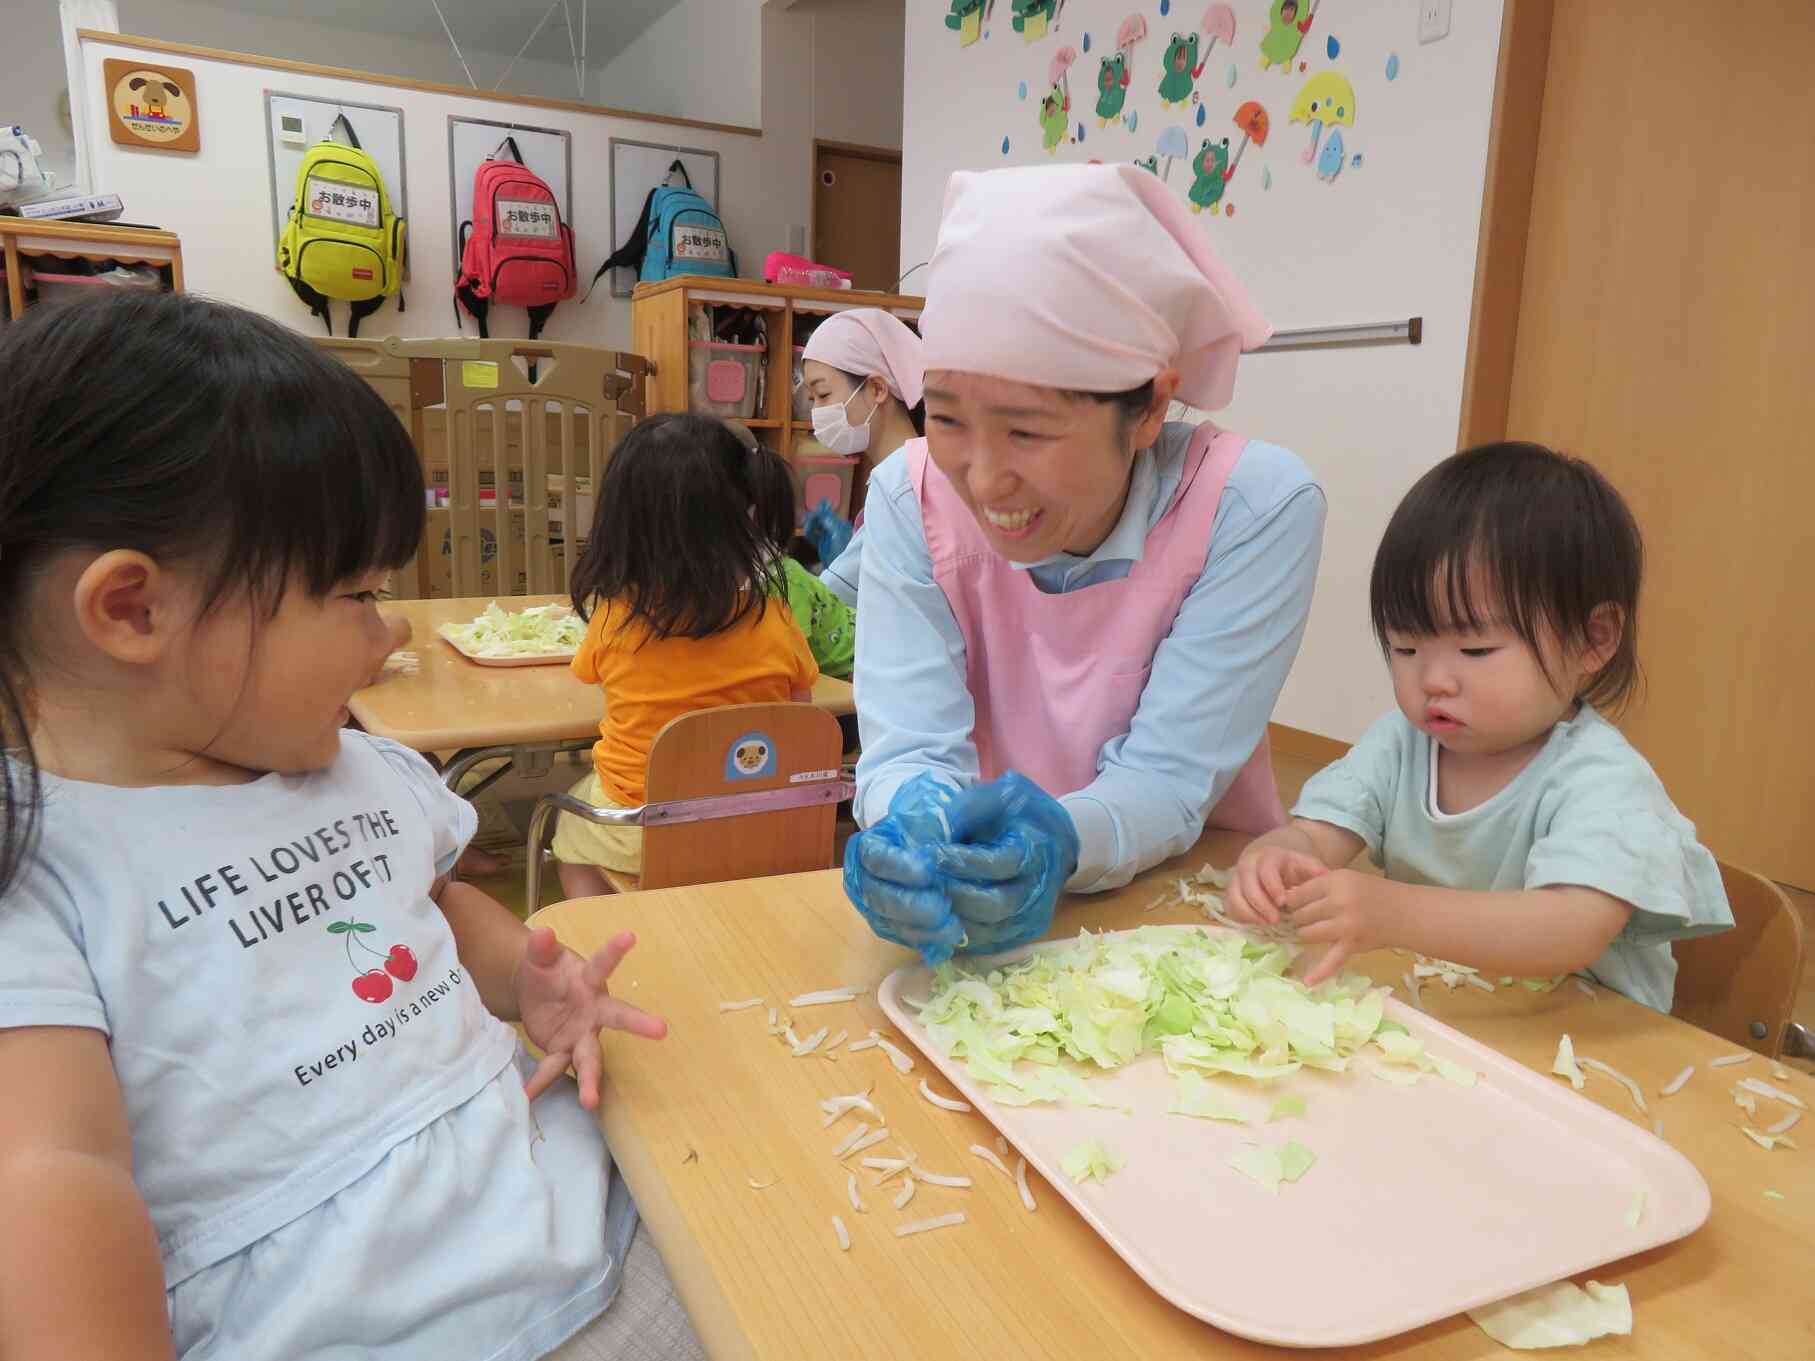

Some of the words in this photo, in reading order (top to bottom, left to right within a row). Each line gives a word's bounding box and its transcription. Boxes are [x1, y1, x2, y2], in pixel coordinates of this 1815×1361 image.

[319, 190, 371, 211] お散歩中
[506, 209, 551, 224] お散歩中
[682, 234, 721, 248] お散歩中
[158, 865, 248, 929] LIFE
[250, 820, 350, 882] LOVES
[353, 810, 399, 842] THE
[228, 883, 330, 948] LIVER
[332, 860, 371, 900] OF
[294, 1039, 358, 1086] Every
[361, 1017, 396, 1046] day
[394, 1007, 410, 1025] is
[409, 1002, 422, 1016] a
[419, 980, 451, 1009] new
